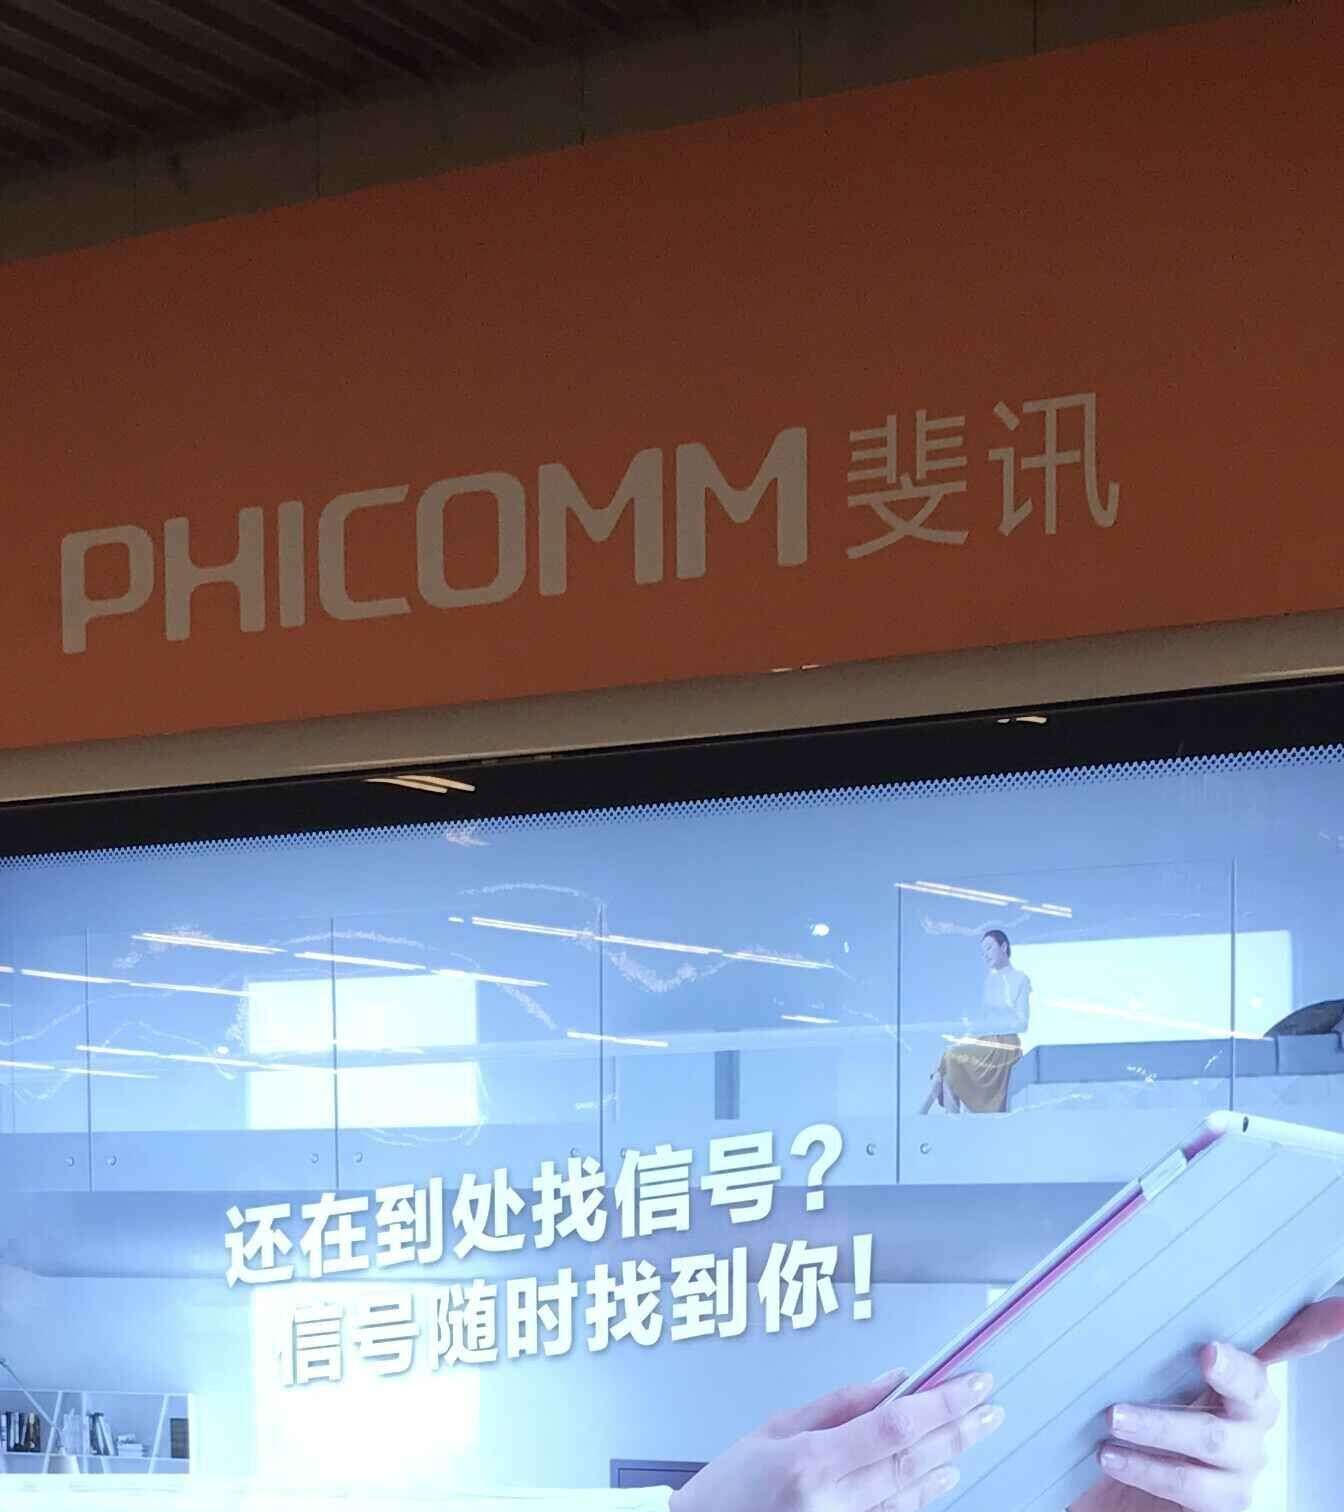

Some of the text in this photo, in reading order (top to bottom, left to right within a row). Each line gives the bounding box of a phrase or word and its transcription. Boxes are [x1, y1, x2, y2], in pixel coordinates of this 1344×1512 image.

[59, 391, 1120, 655] PHICOMM 斐讯
[223, 1123, 844, 1288] 还在到处找信号？
[280, 1233, 873, 1388] 信号随时找到你！
